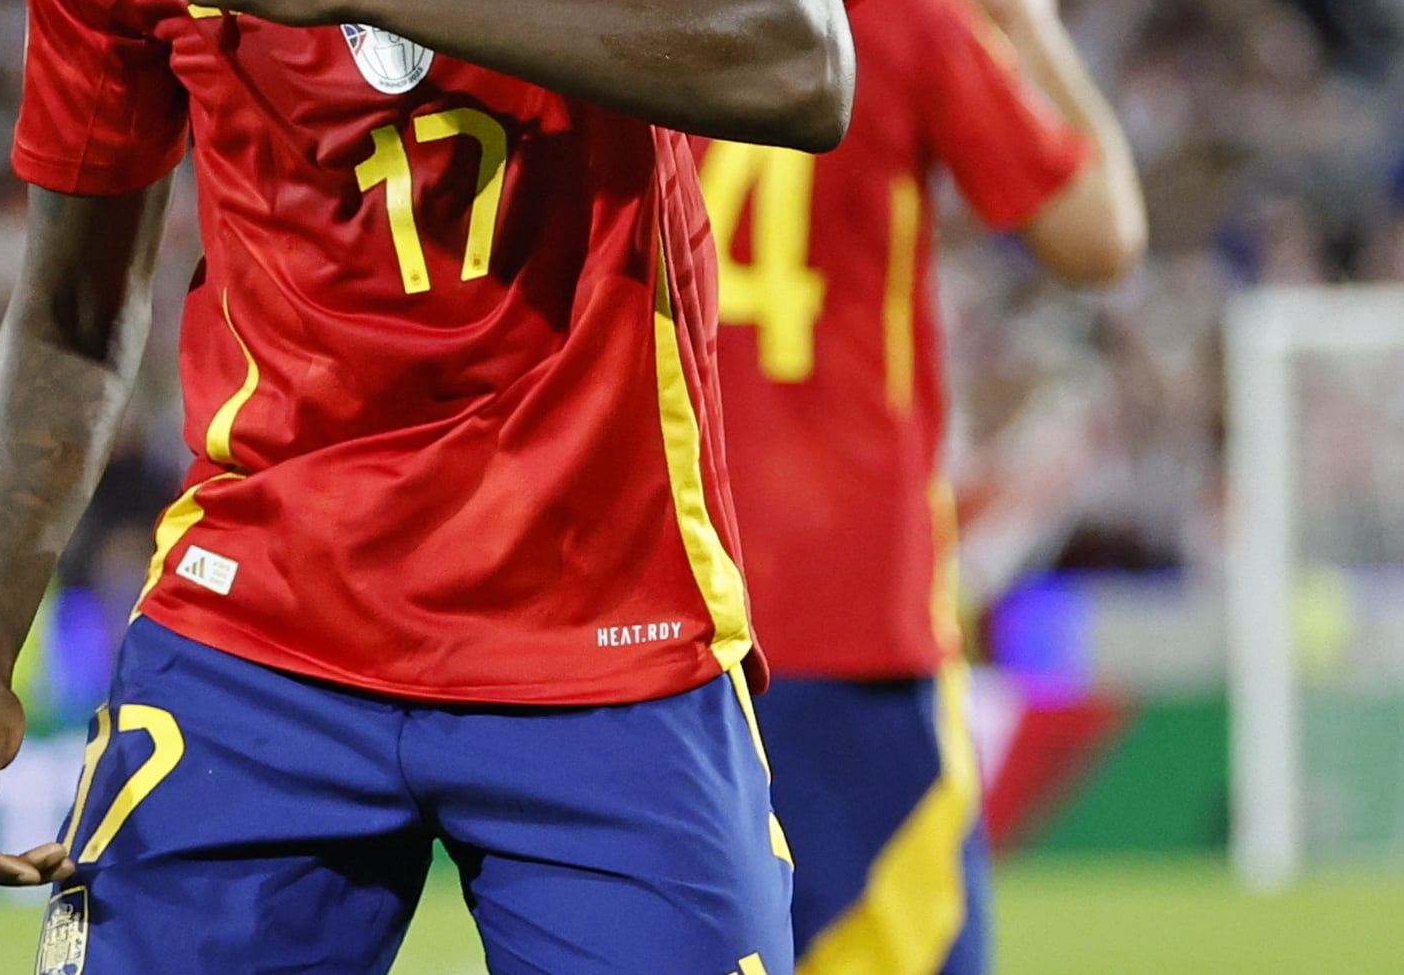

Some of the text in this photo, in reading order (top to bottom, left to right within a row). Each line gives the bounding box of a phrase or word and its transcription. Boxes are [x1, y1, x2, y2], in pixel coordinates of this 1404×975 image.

[354, 107, 507, 295] 17
[700, 139, 827, 383] 4
[597, 621, 682, 647] HEAT.RDY
[63, 701, 186, 864] 17
